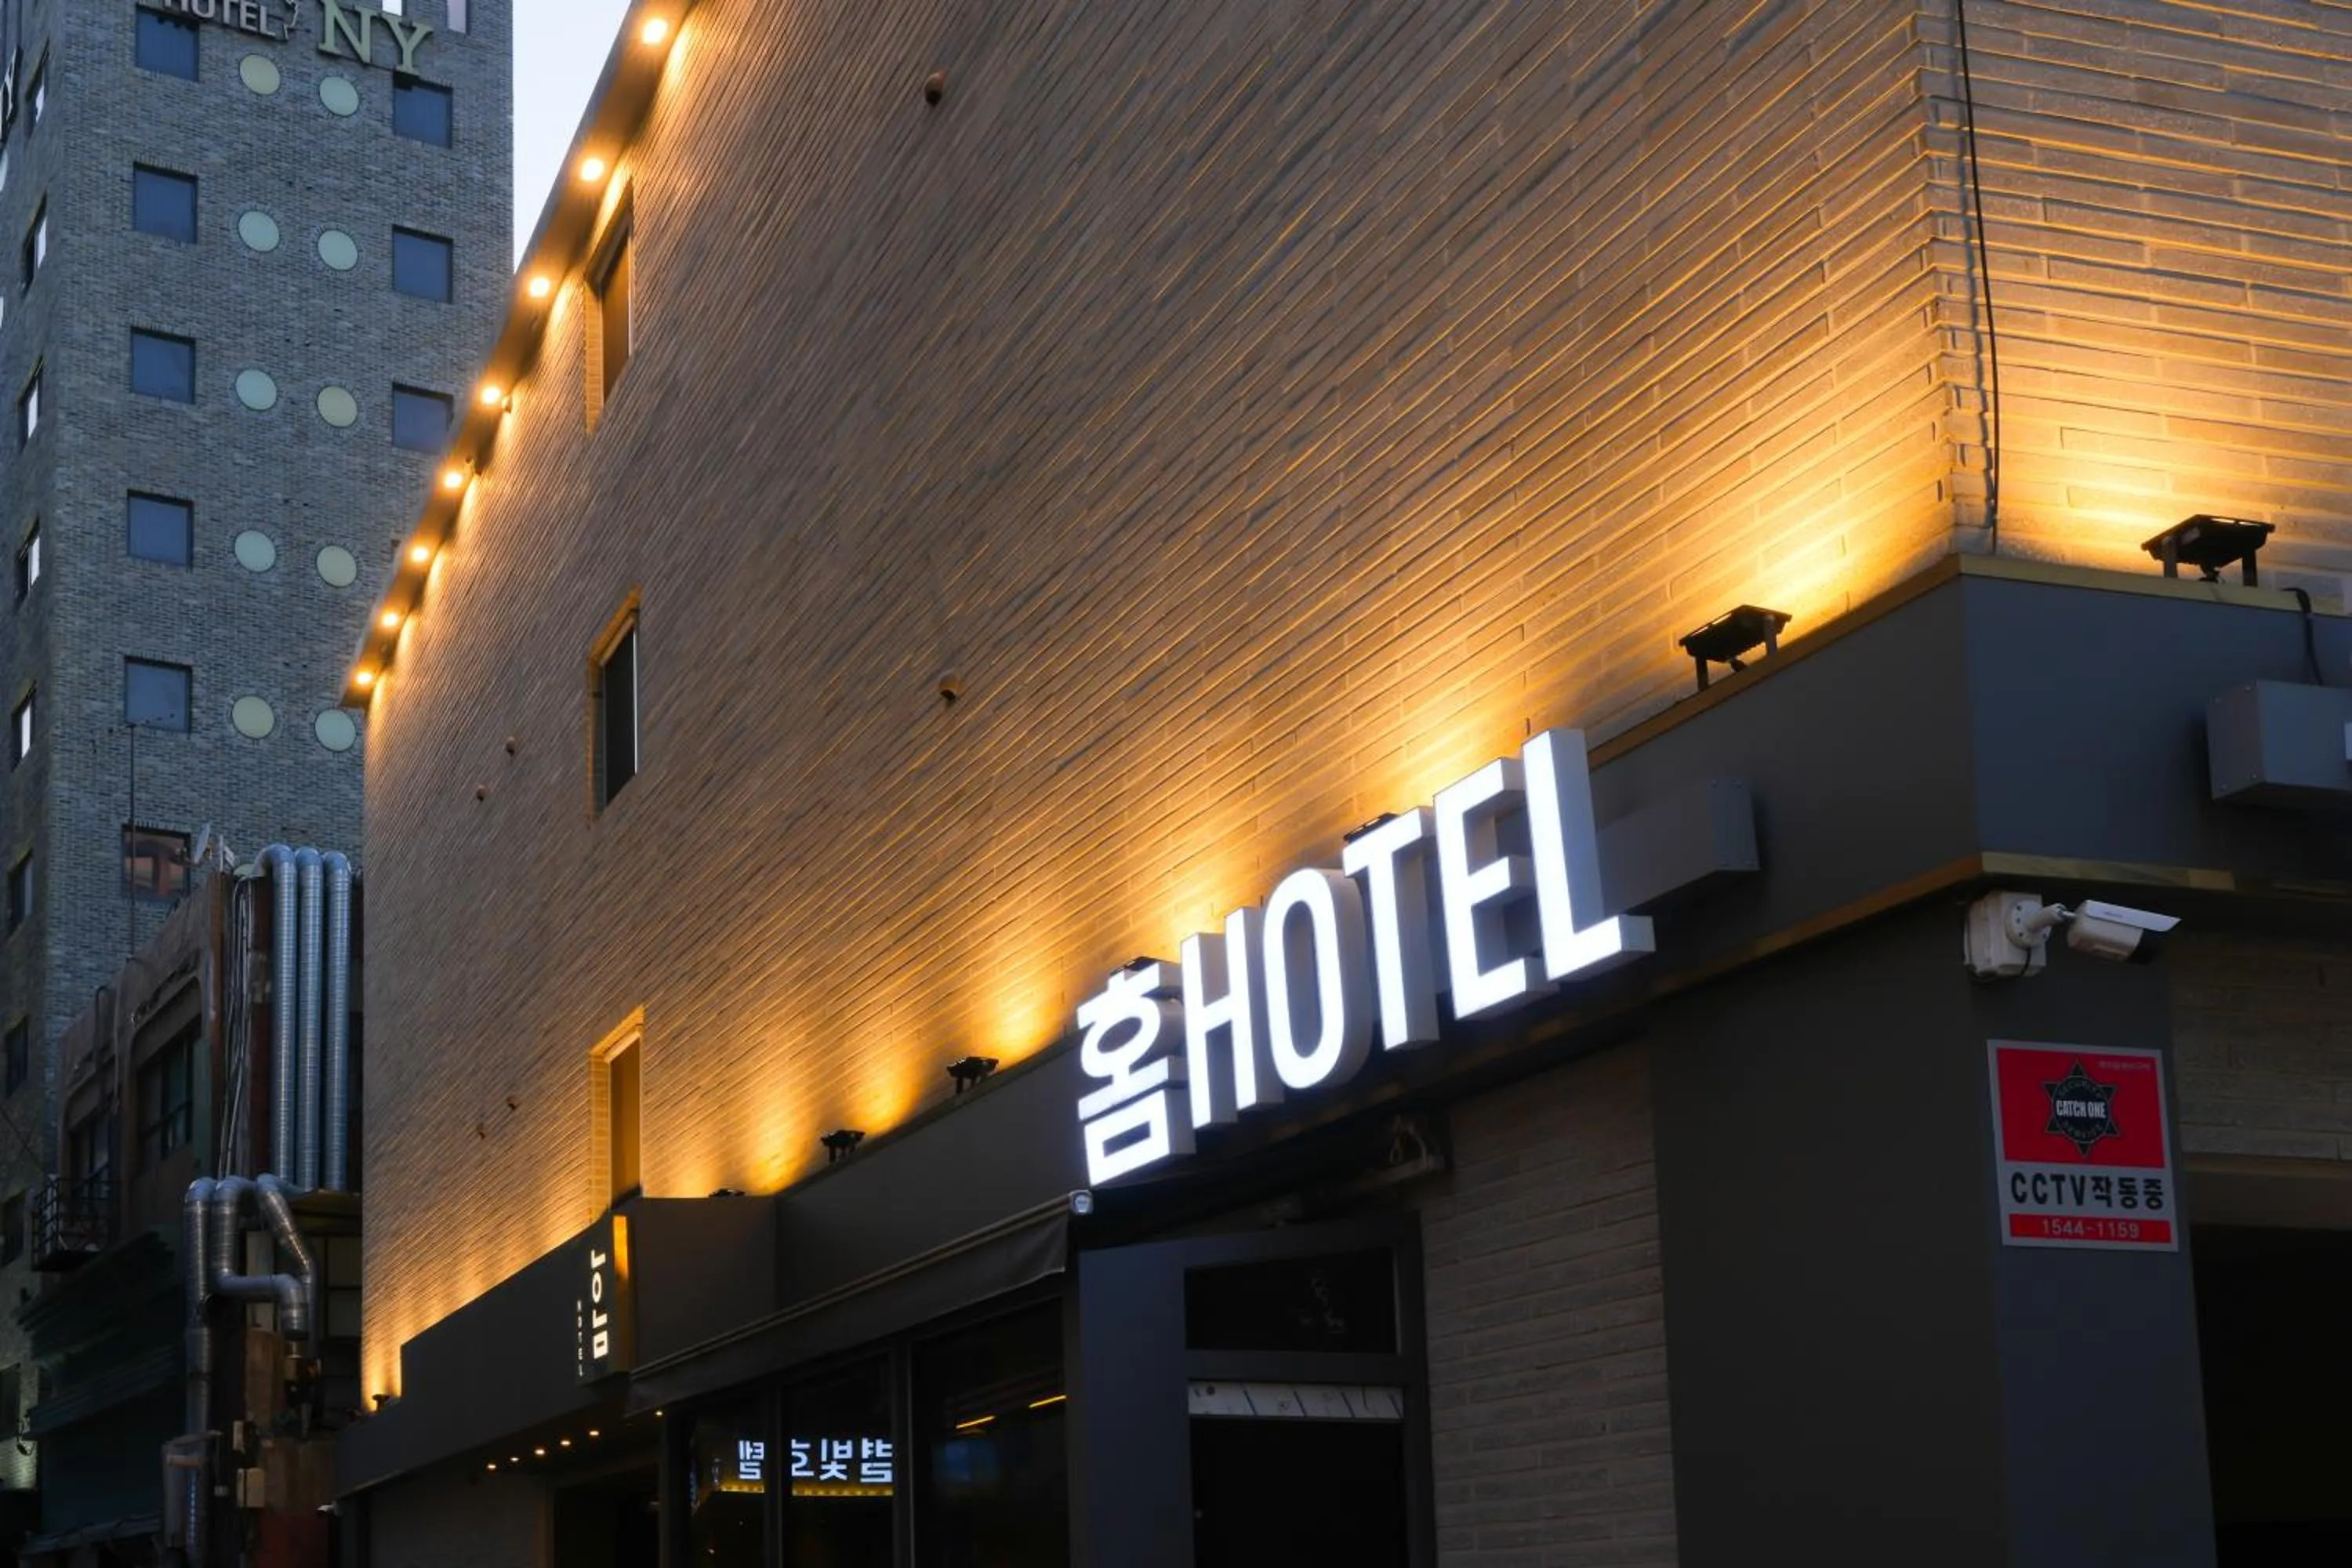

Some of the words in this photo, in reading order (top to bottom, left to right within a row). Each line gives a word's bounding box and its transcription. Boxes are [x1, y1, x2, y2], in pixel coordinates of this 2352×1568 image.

[318, 0, 433, 74] NY
[2056, 1100, 2086, 1117] CATCH
[2088, 1101, 2107, 1119] ONE
[2011, 1172, 2163, 1210] CCTV작동중
[2042, 1218, 2140, 1239] 1544-1159
